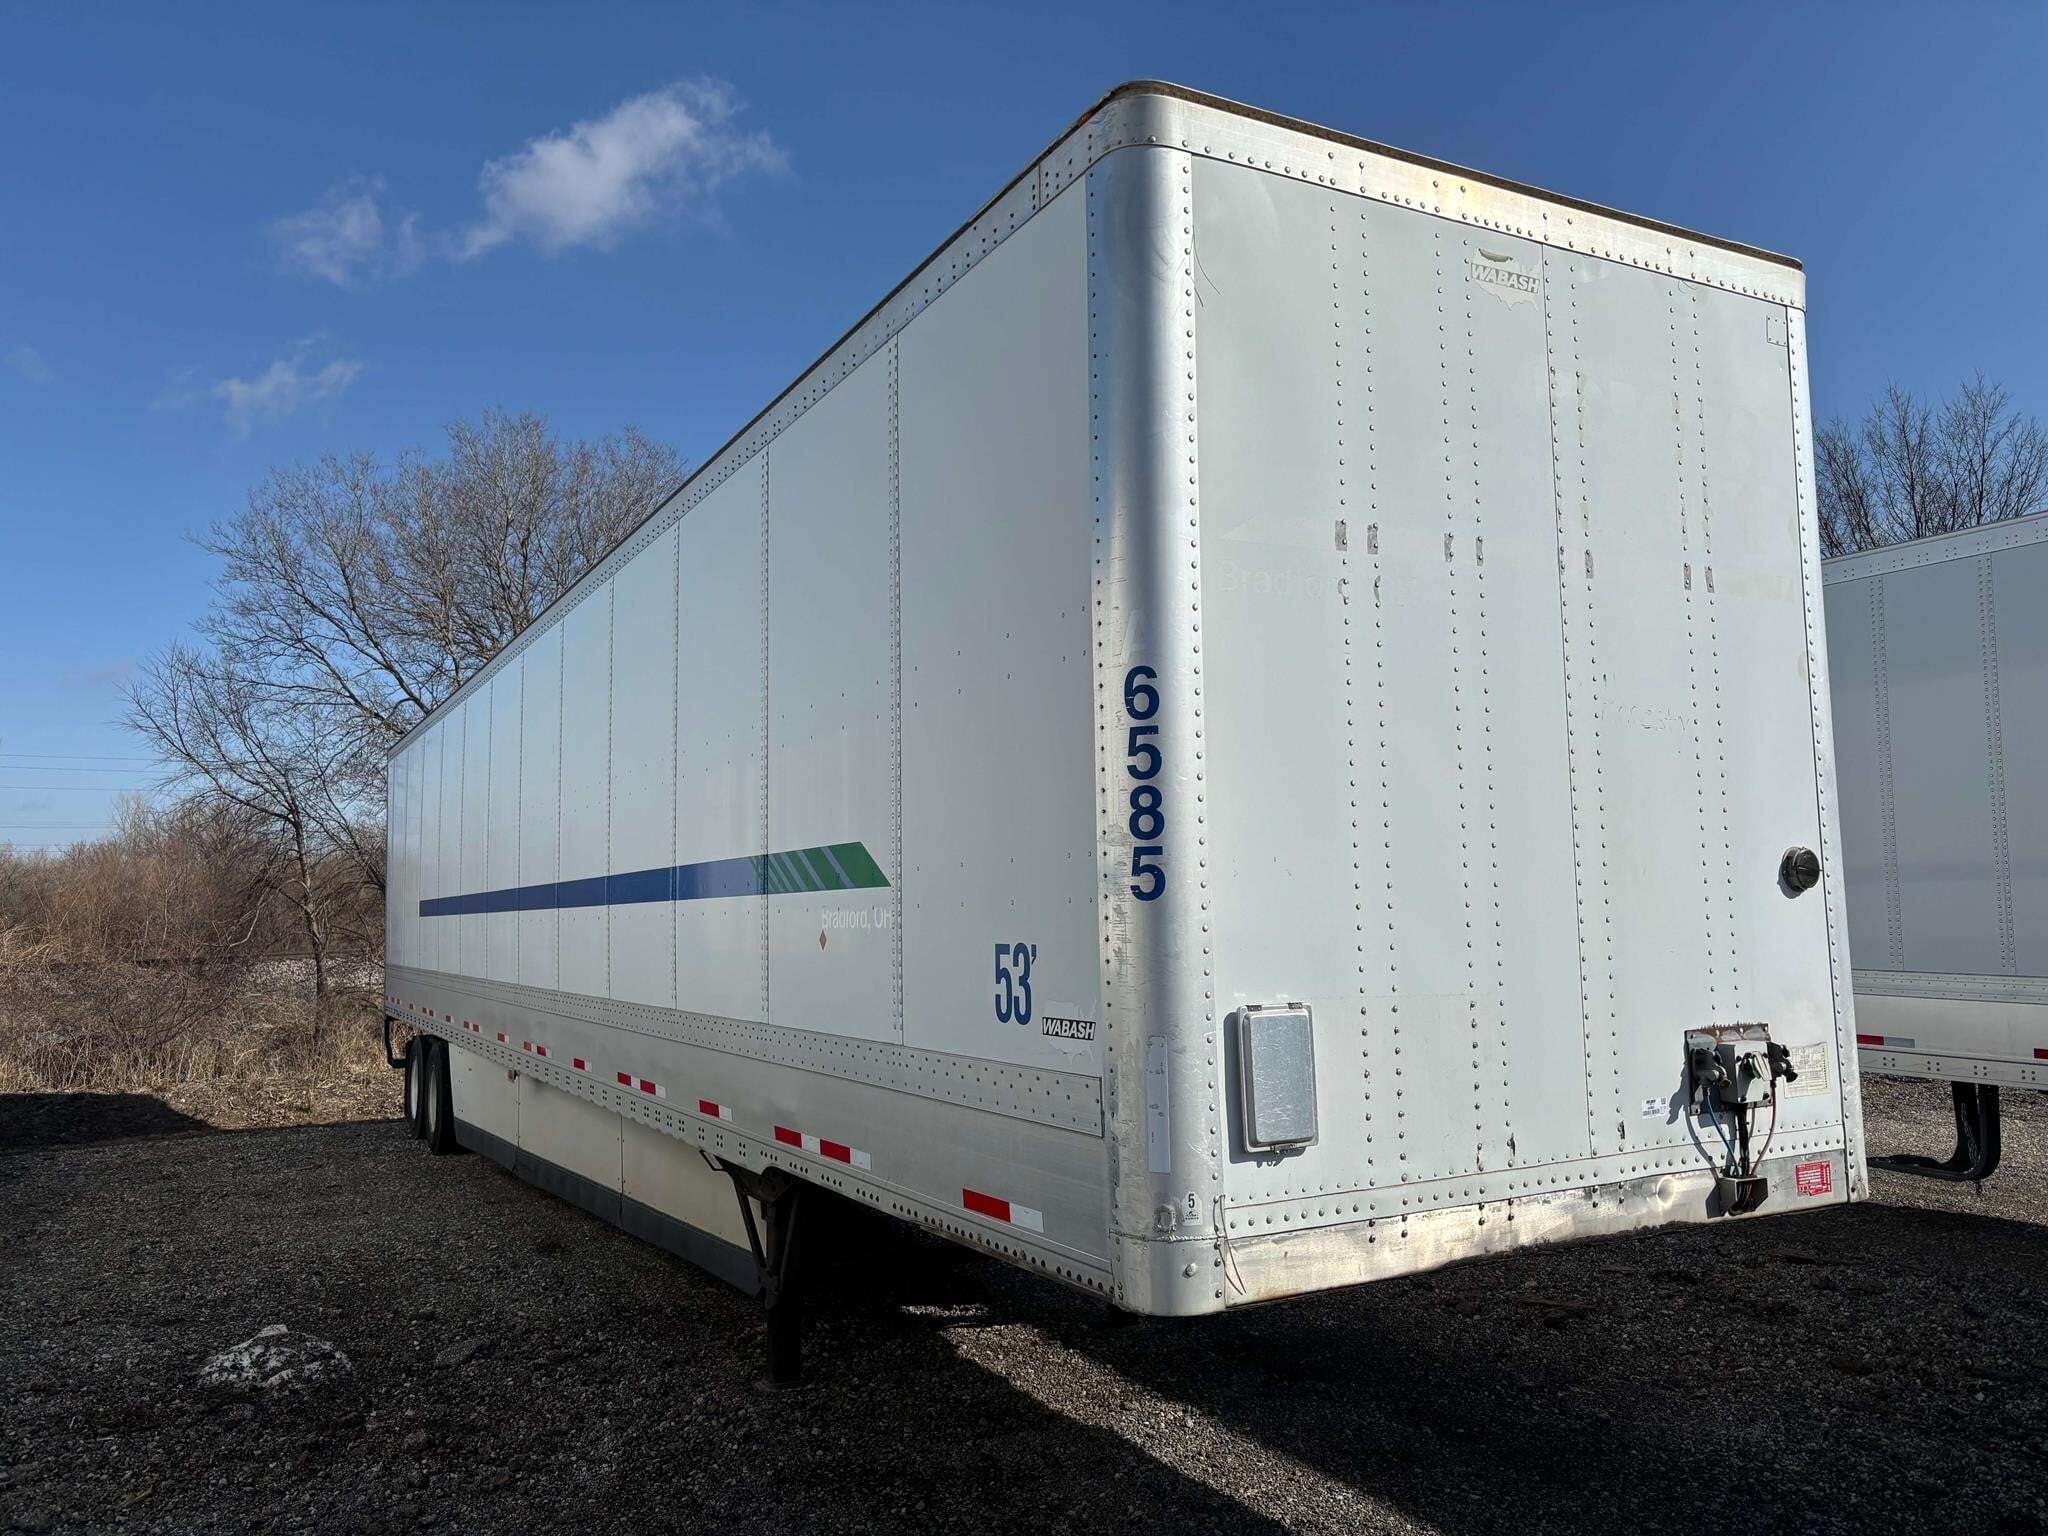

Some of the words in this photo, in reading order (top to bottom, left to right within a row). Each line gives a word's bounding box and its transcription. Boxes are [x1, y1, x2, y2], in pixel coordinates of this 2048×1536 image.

[1471, 264, 1540, 292] WABASH
[1124, 665, 1166, 902] 6585
[1042, 1017, 1096, 1040] WABASH
[1188, 1193, 1195, 1209] 5
